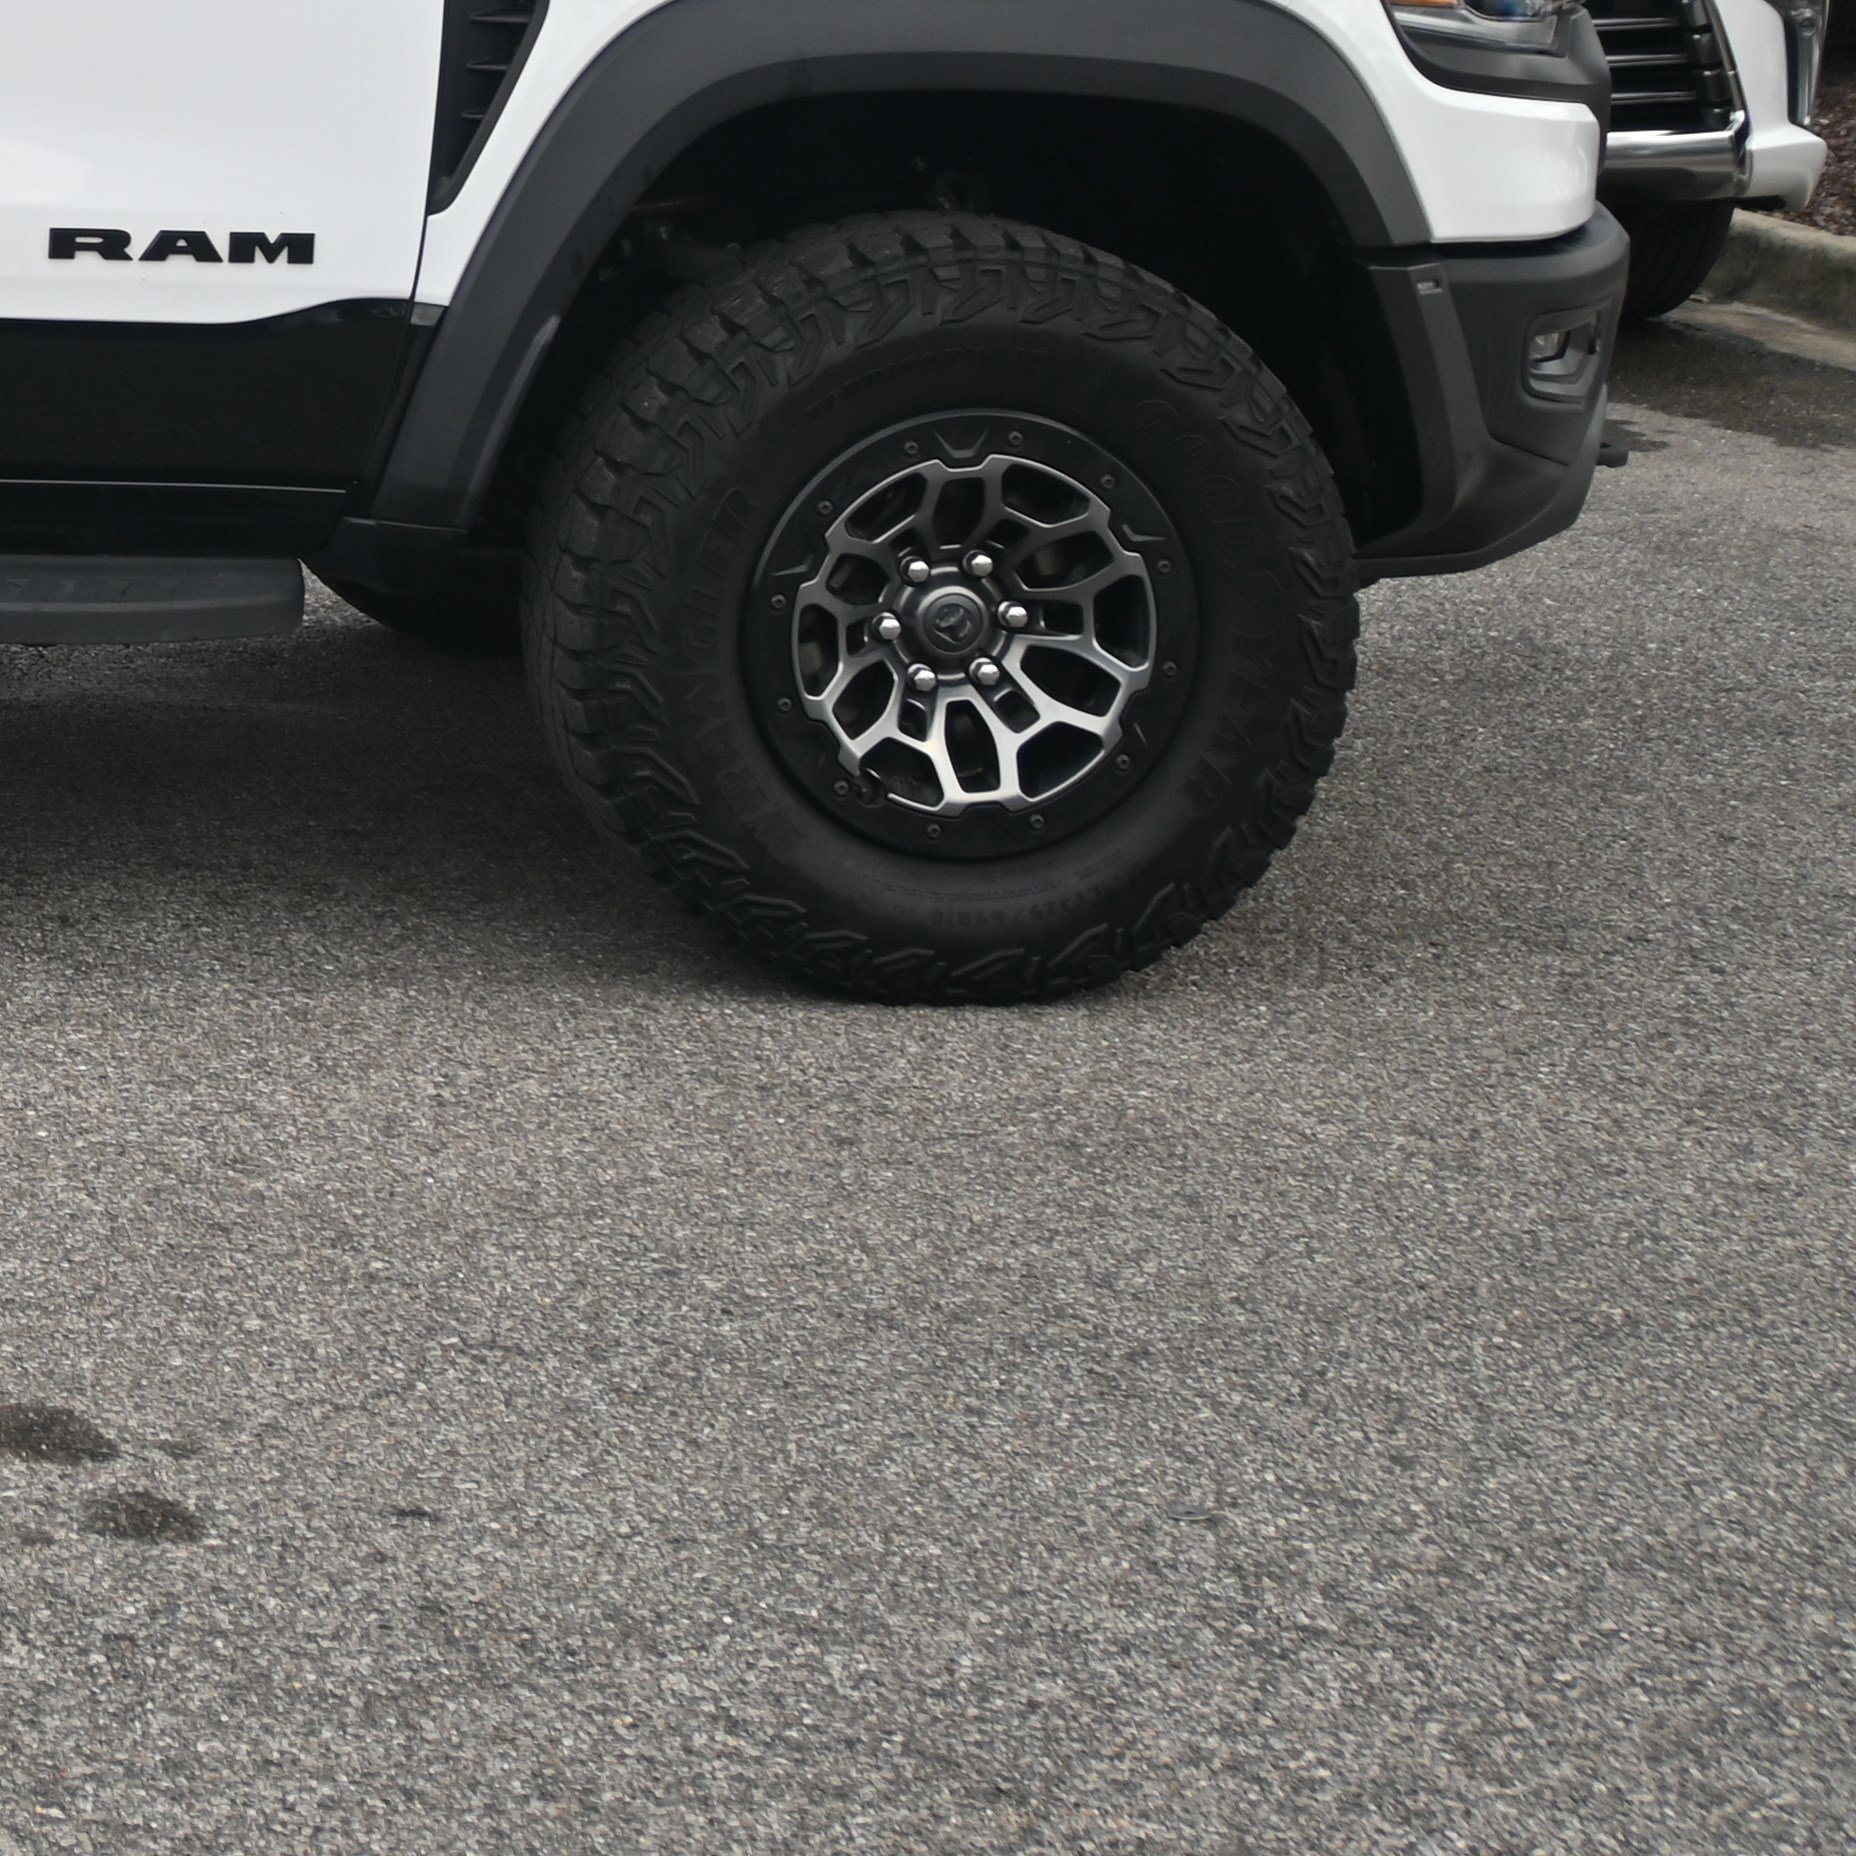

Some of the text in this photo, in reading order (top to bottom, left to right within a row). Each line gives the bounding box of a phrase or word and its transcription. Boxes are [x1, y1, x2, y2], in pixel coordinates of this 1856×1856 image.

[48, 227, 316, 265] RAM
[685, 487, 805, 860] WRANGLER
[1130, 398, 1286, 817] GOODYEAR
